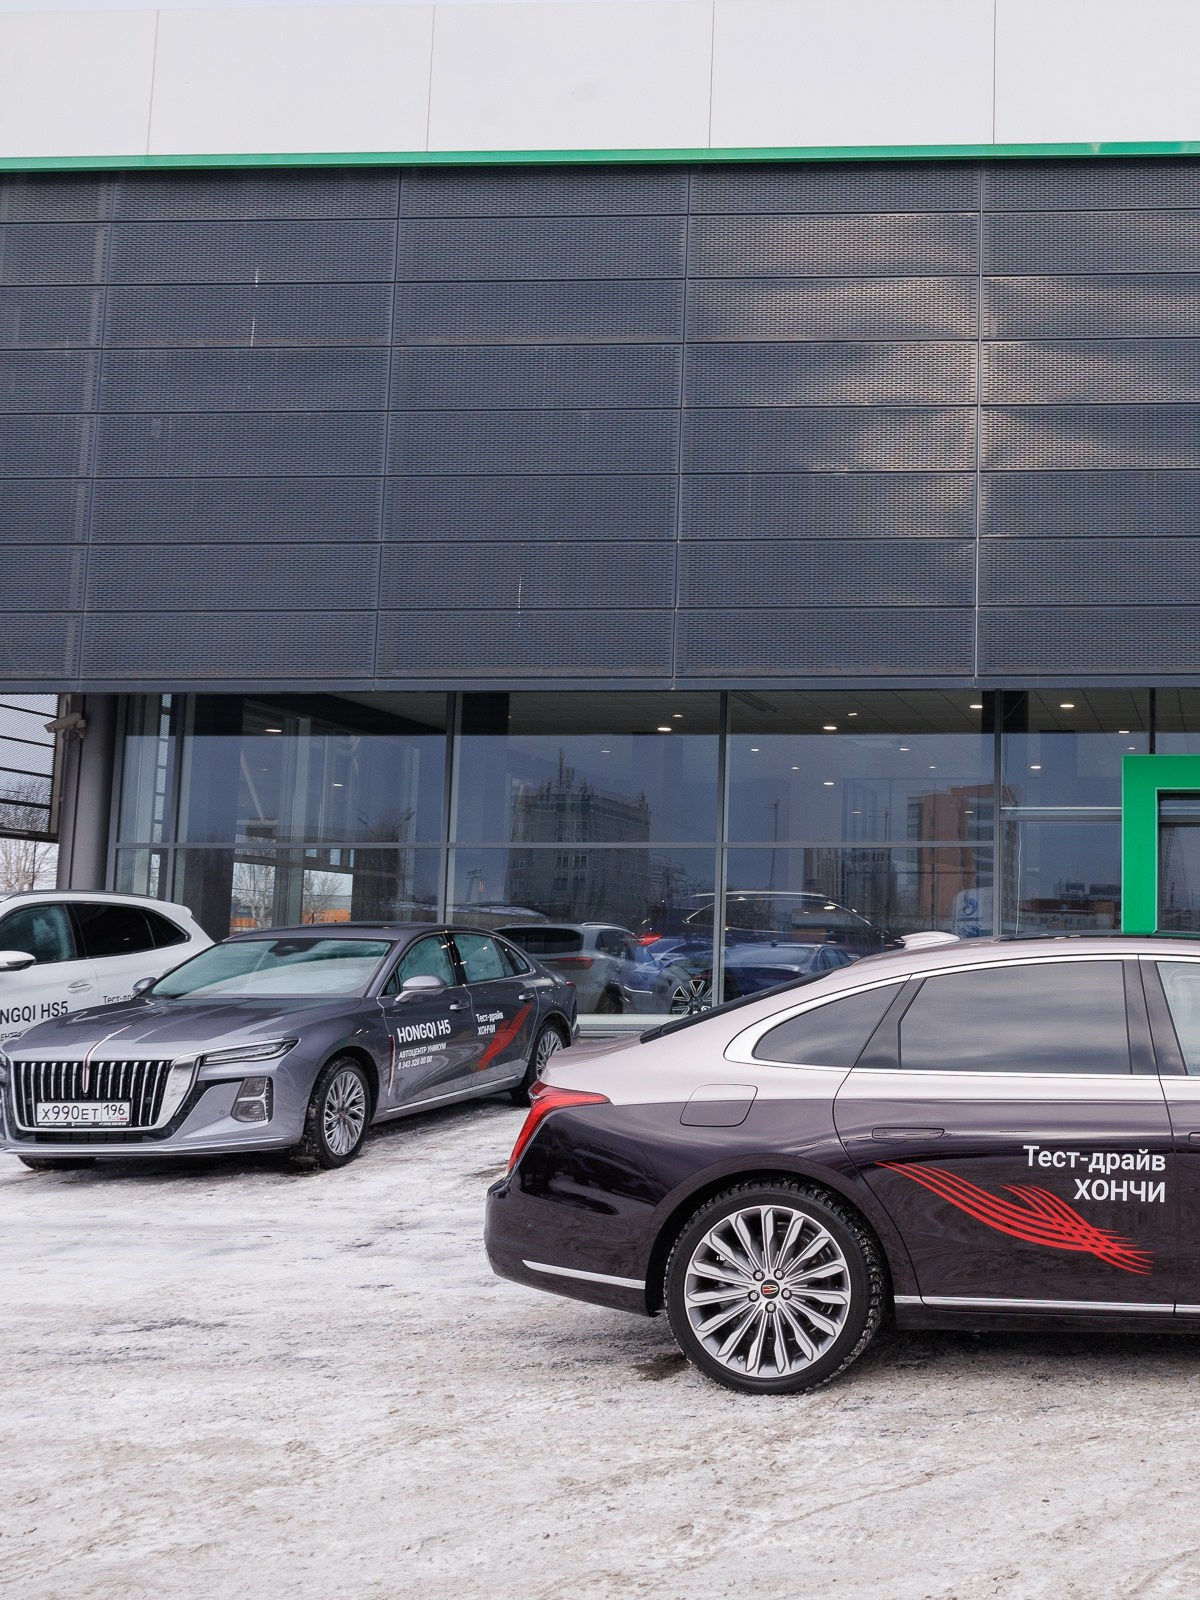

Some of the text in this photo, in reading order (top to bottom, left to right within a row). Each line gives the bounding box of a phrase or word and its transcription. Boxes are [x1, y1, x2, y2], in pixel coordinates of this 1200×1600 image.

[41, 1001, 68, 1019] HS5
[476, 1011, 503, 1022] Тест-драйв
[397, 1019, 451, 1043] HONGQI H5
[478, 1025, 495, 1036] ХОНЧИ
[399, 1042, 447, 1058] АВТОЦЕНТР УНИКУМ
[402, 1060, 410, 1069] 343
[411, 1058, 419, 1067] 328
[420, 1057, 426, 1065] 00
[426, 1056, 433, 1064] 00
[42, 1104, 125, 1120] Х990ЕТ 196
[1023, 1145, 1166, 1175] Тест-драйв
[1073, 1178, 1166, 1203] ХОНЧИ
